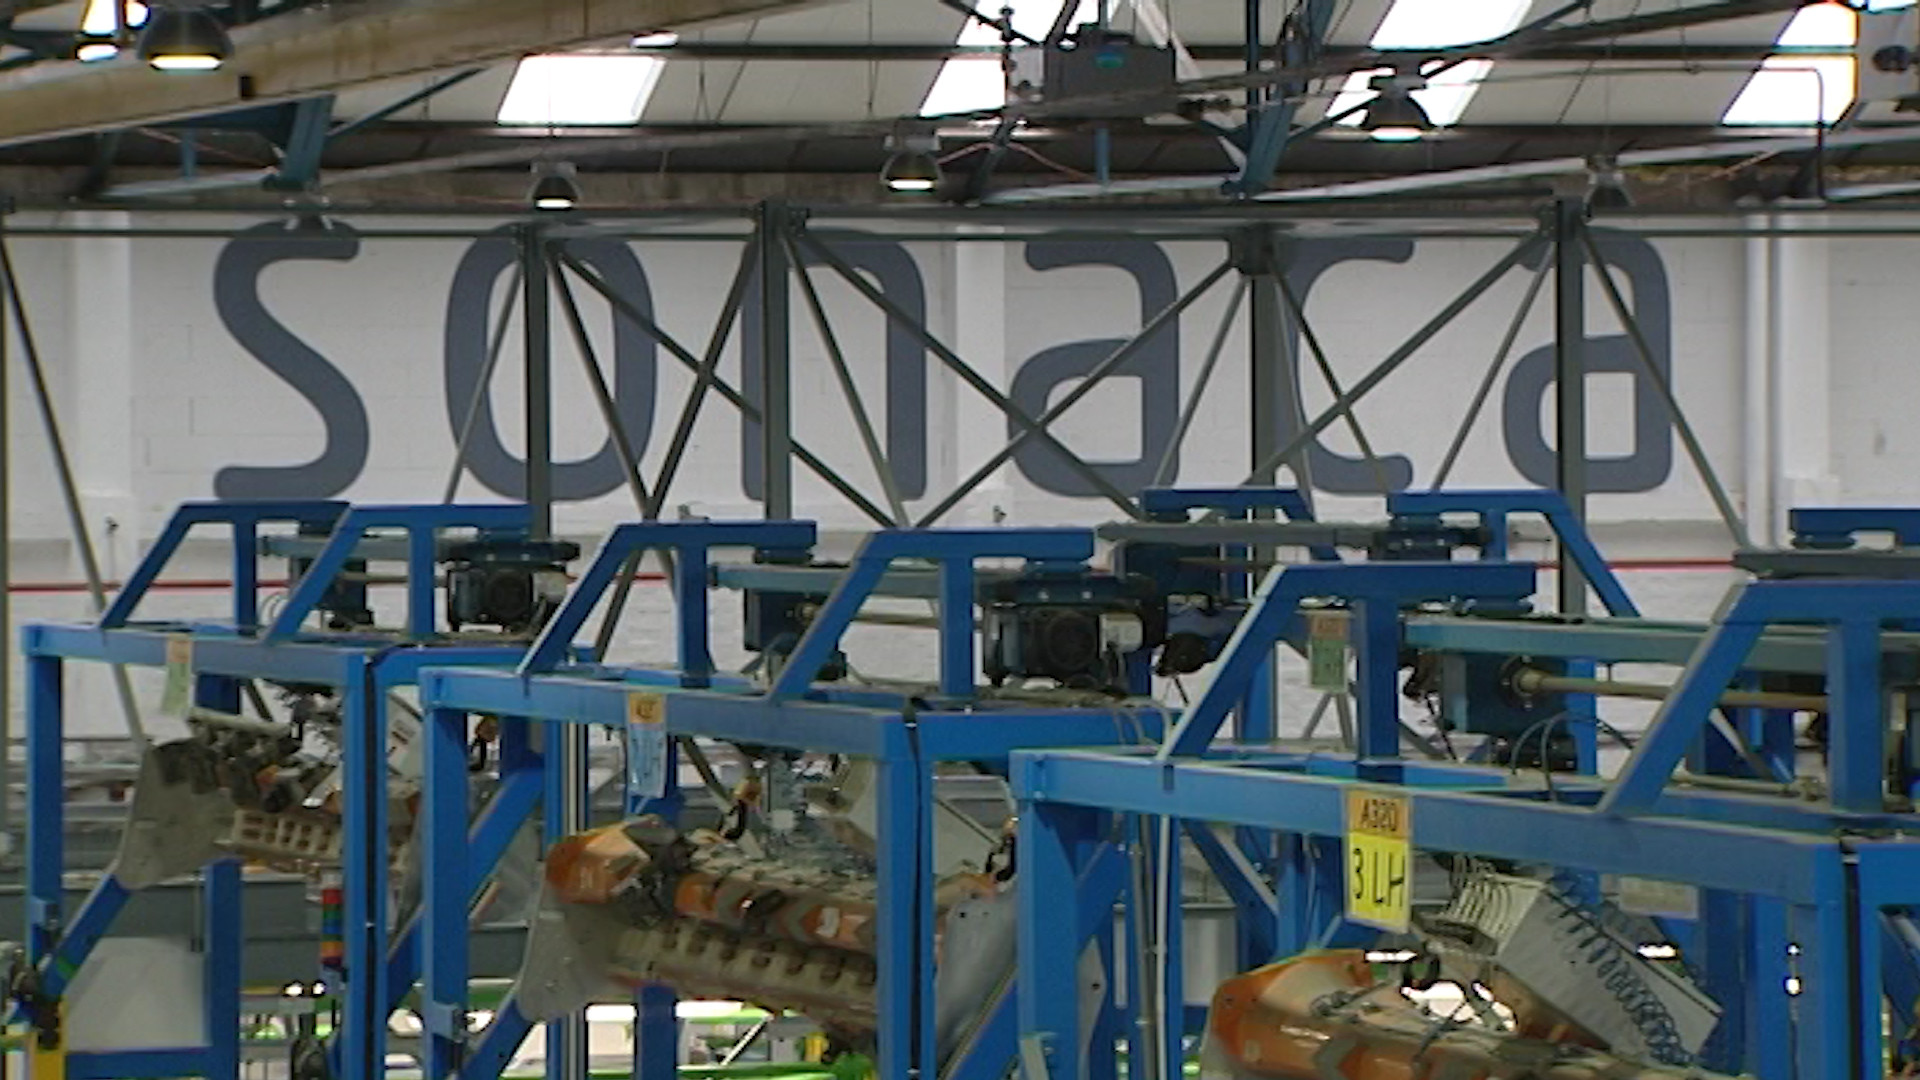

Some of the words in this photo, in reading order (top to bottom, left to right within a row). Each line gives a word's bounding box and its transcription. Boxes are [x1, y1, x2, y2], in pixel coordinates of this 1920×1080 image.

[213, 221, 1671, 501] sonaca
[1360, 798, 1398, 833] A320
[1352, 847, 1364, 900] 3
[1372, 851, 1406, 908] LH
